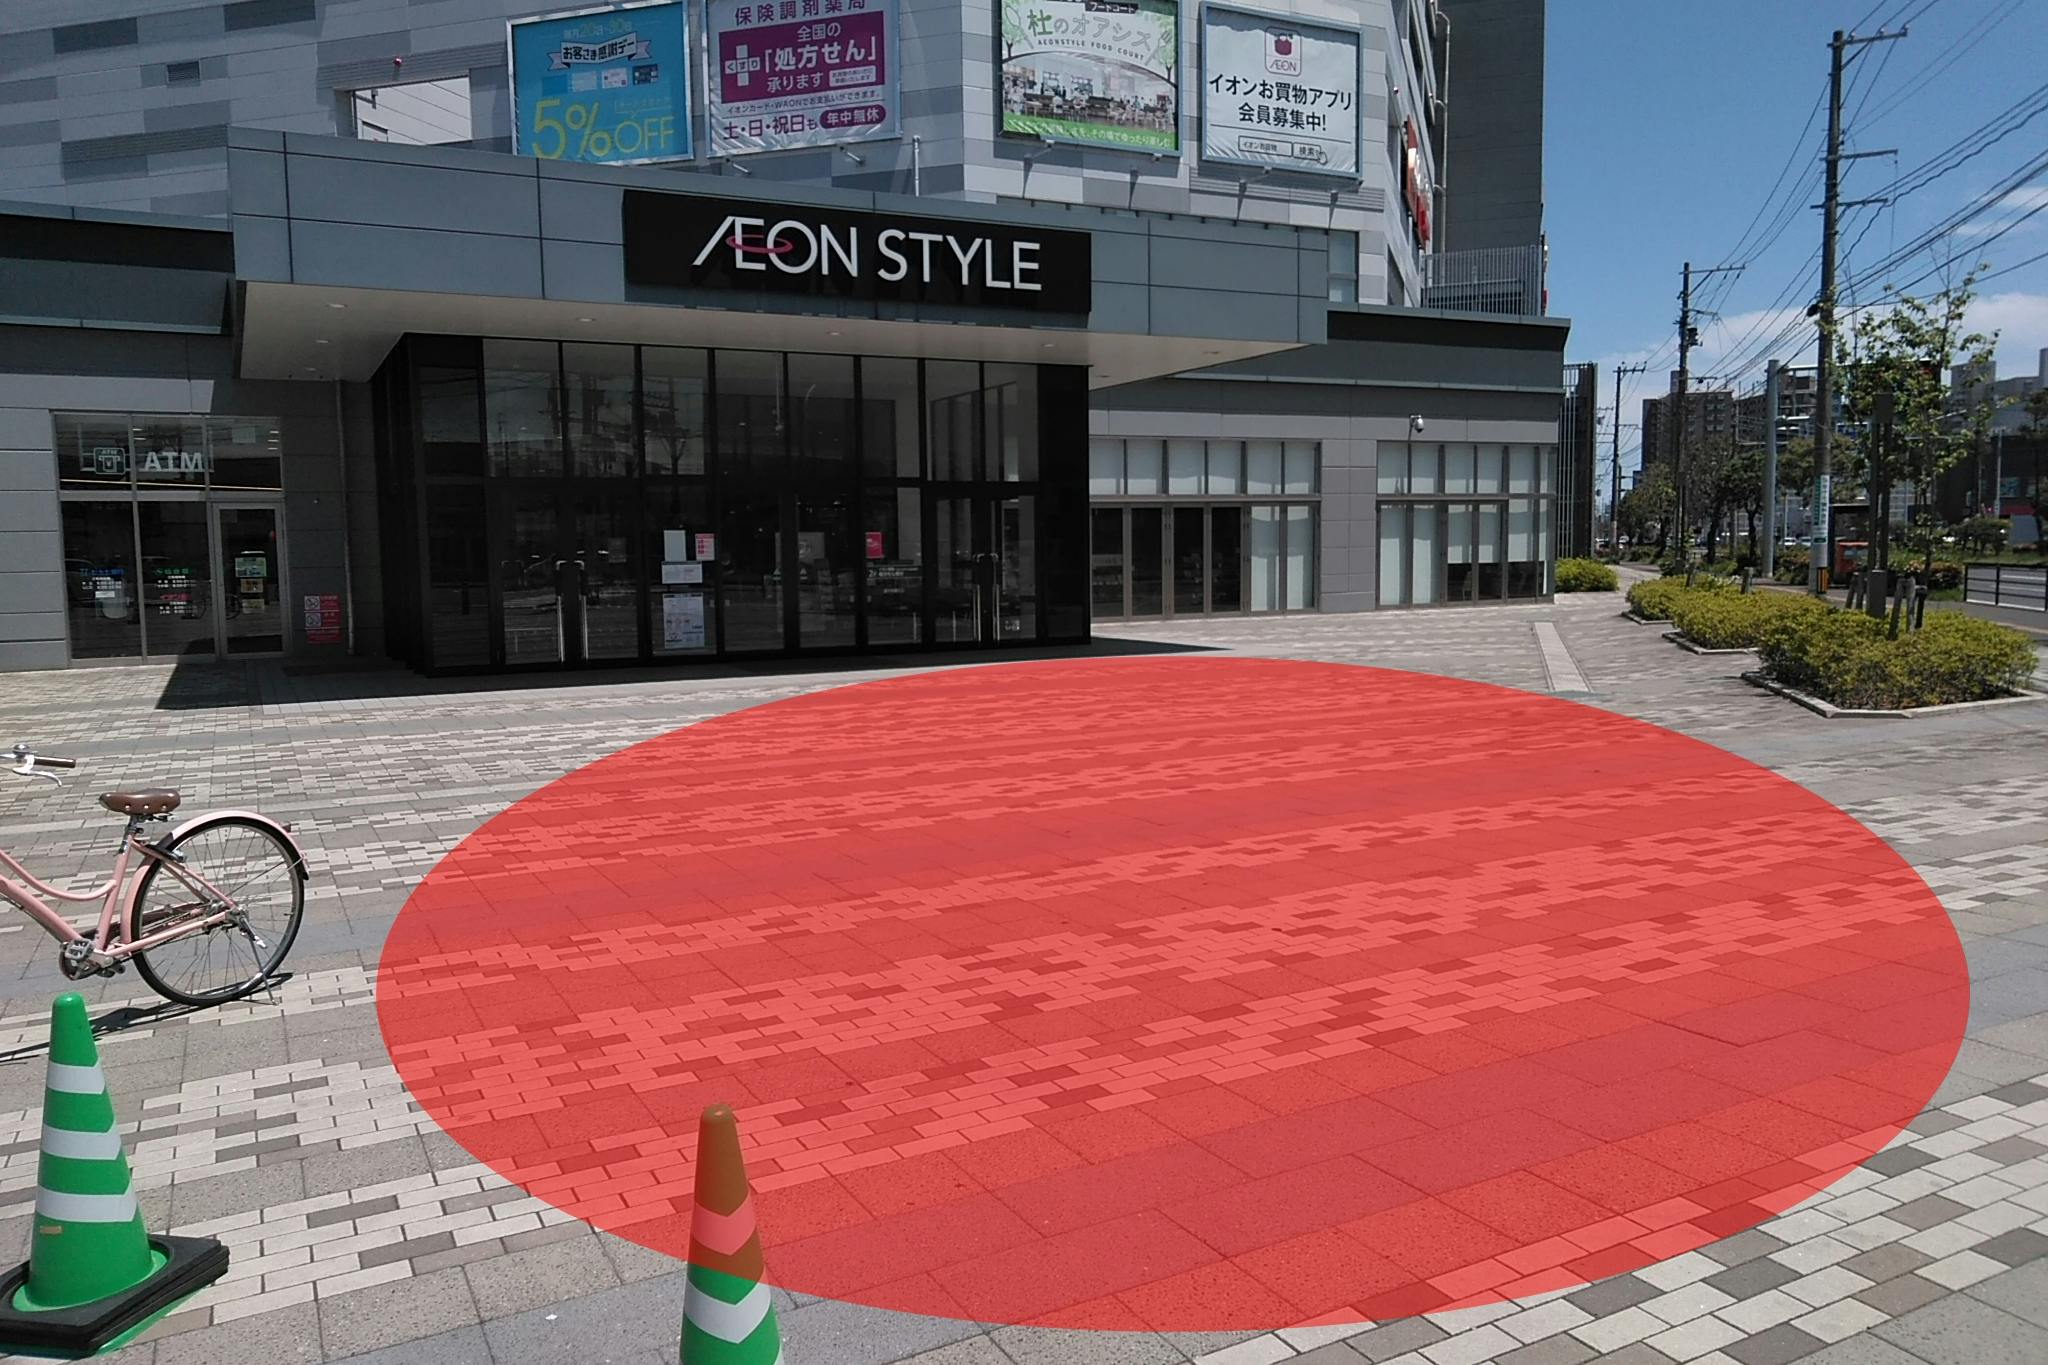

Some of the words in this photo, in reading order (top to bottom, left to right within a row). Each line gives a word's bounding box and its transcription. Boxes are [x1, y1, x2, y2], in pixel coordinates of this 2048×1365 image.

[797, 22, 842, 43] 全国の
[1027, 9, 1152, 51] 杜のオアシス
[562, 39, 636, 61] お客さま感謝デー
[764, 35, 877, 74] 「処方せん」
[1090, 42, 1114, 52] FOOD
[1117, 47, 1145, 61] COURT
[767, 72, 824, 93] 承ります
[1209, 73, 1352, 111] イオンお買物アプリ
[826, 108, 880, 126] 年中無休
[1238, 102, 1327, 132] 会員募集中!
[877, 228, 1042, 291] STYLE
[143, 451, 205, 473] ATM
